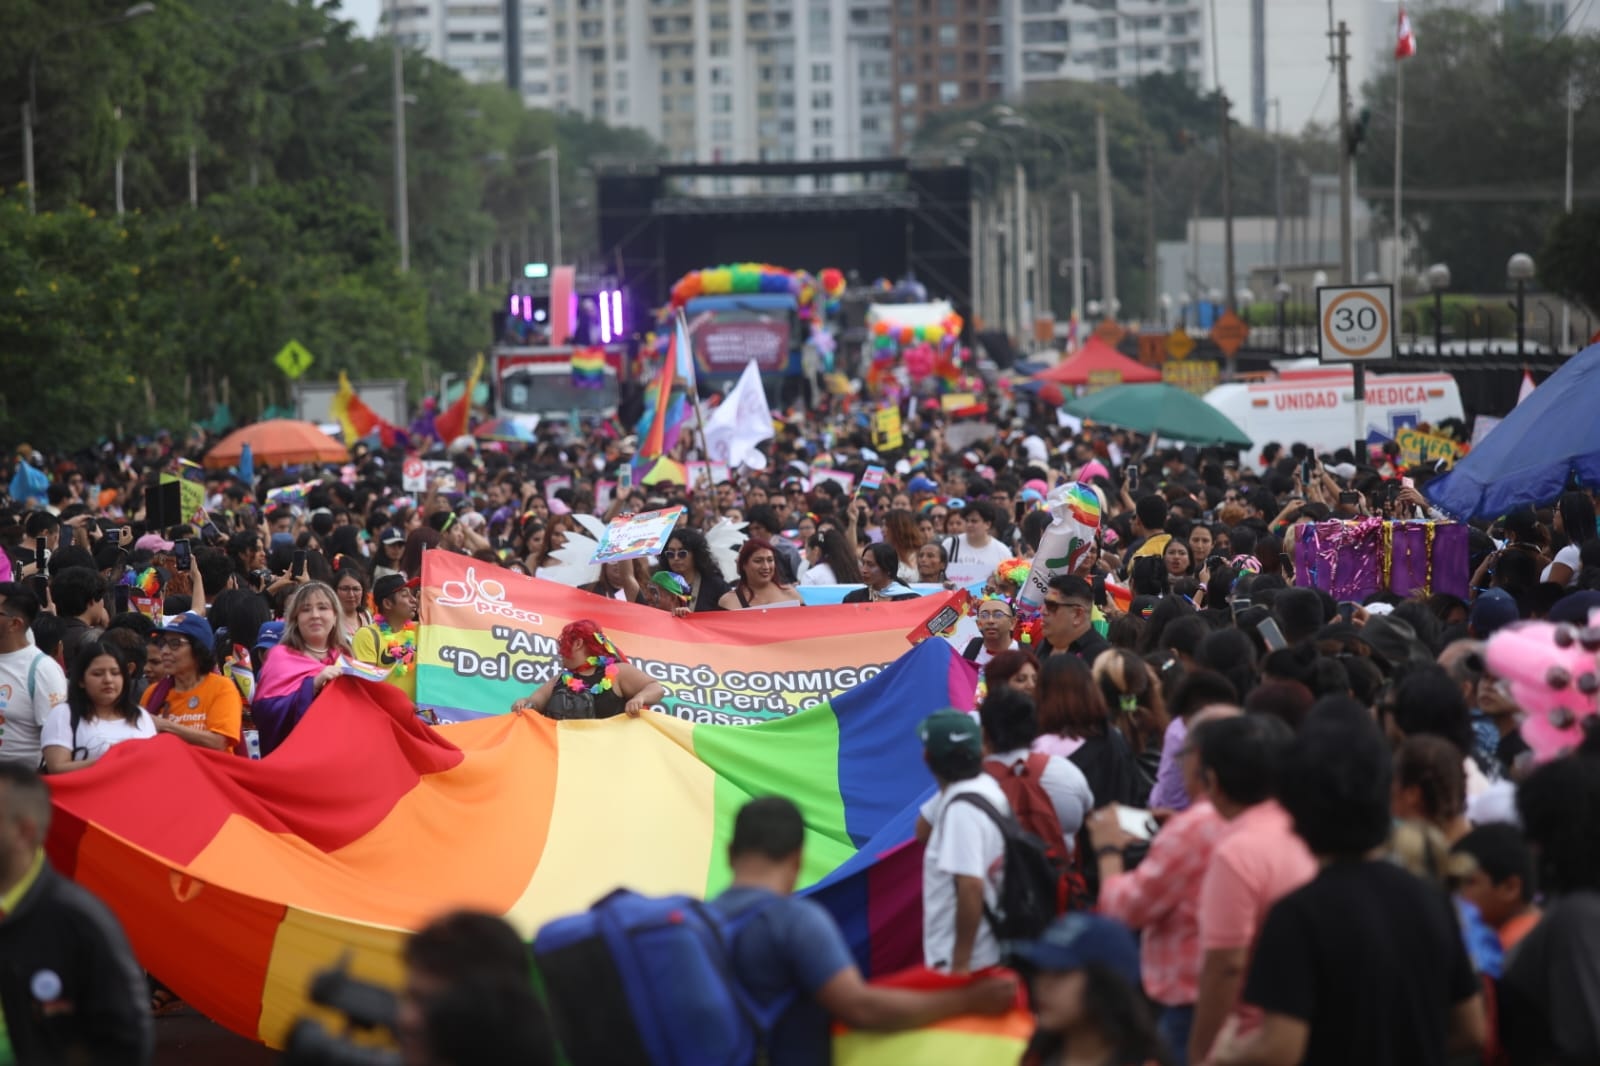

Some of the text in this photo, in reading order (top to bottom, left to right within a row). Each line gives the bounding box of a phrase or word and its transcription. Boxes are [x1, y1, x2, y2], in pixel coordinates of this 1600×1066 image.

[1335, 306, 1377, 332] 30
[1274, 385, 1428, 411] UNIDAD MEDICA
[475, 600, 542, 625] prosa
[495, 627, 558, 655] "AM
[627, 658, 716, 687] IGRÓ
[516, 660, 562, 682] ext
[679, 688, 704, 704] al
[714, 690, 794, 714] Perú,
[169, 712, 207, 723] Partners
